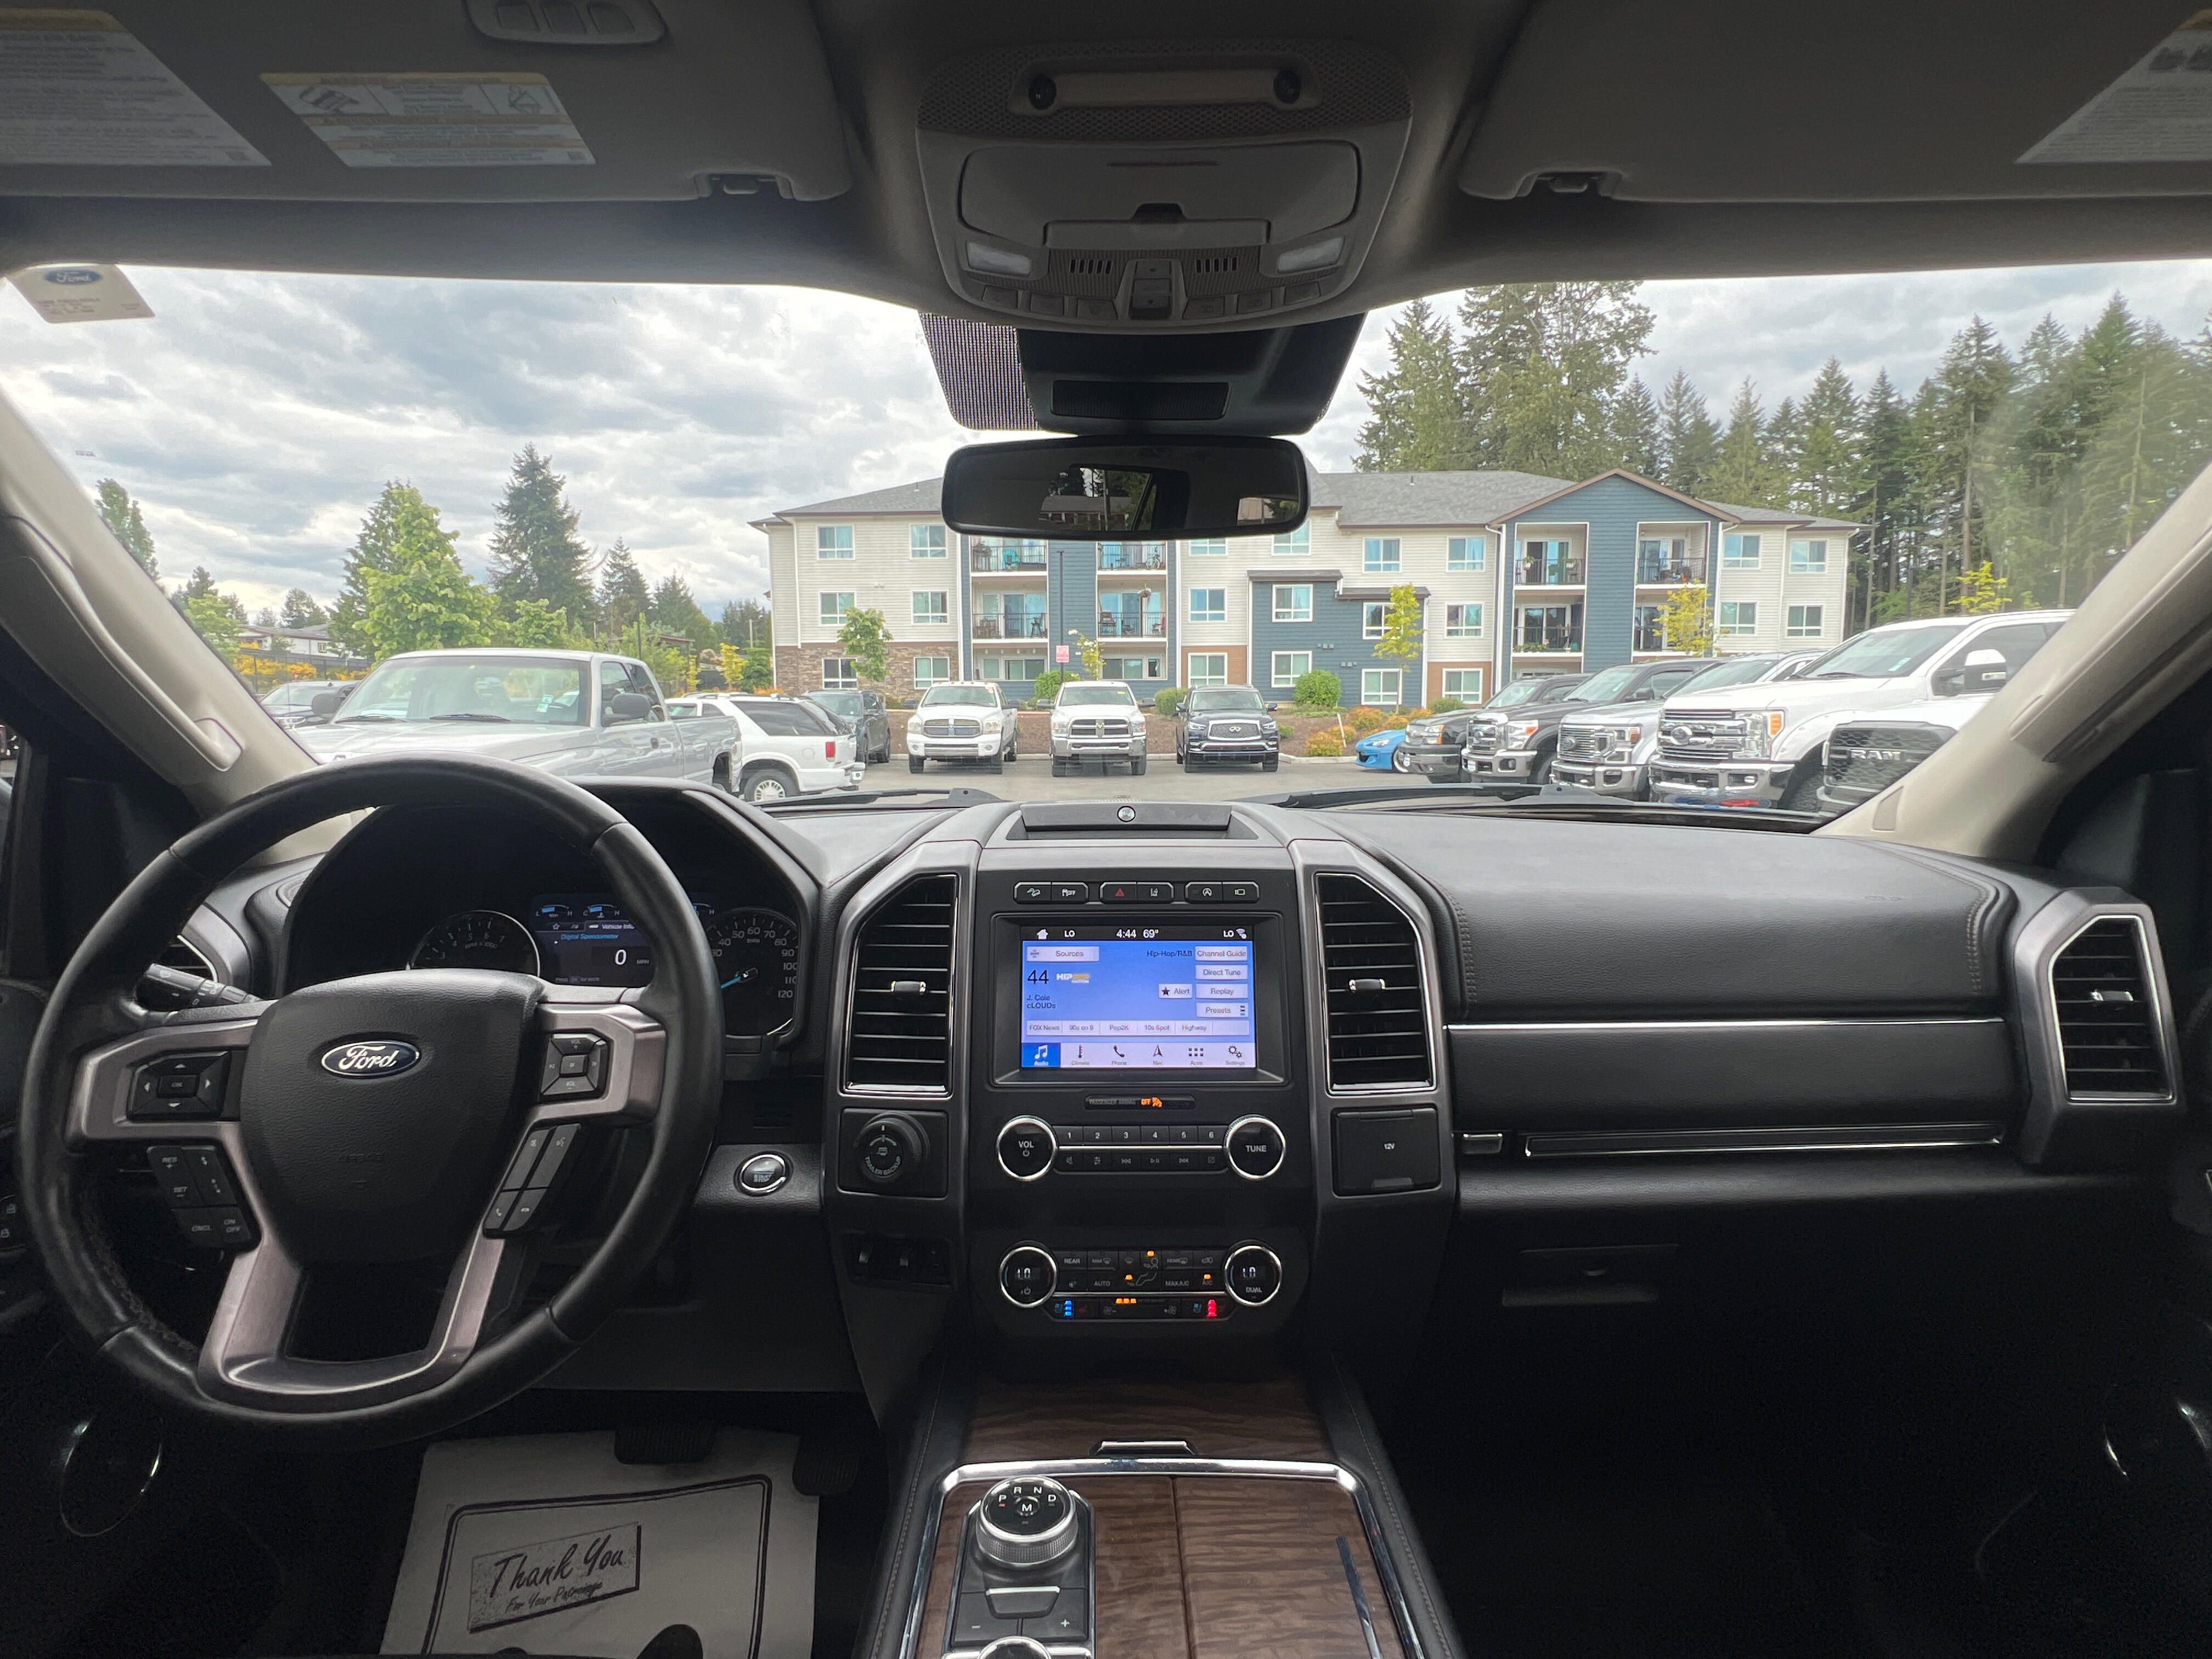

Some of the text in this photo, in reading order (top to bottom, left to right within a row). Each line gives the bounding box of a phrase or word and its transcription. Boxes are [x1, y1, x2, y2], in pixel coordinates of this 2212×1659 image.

[57, 271, 92, 283] Ford
[1850, 749, 1901, 760] RAM
[747, 927, 760, 935] 60
[1116, 929, 1137, 938] 4:44
[718, 938, 731, 946] 40
[774, 938, 787, 946] 80
[615, 949, 627, 966] 0
[781, 949, 795, 957] 90
[783, 962, 798, 970] 100
[1027, 969, 1049, 984] 44
[777, 990, 793, 998] 120
[338, 1045, 400, 1070] Ford
[865, 1155, 901, 1175] TRAILER BACKUP
[489, 1534, 624, 1599] Thank You
[505, 1596, 524, 1613] For
[528, 1593, 549, 1609] Your
